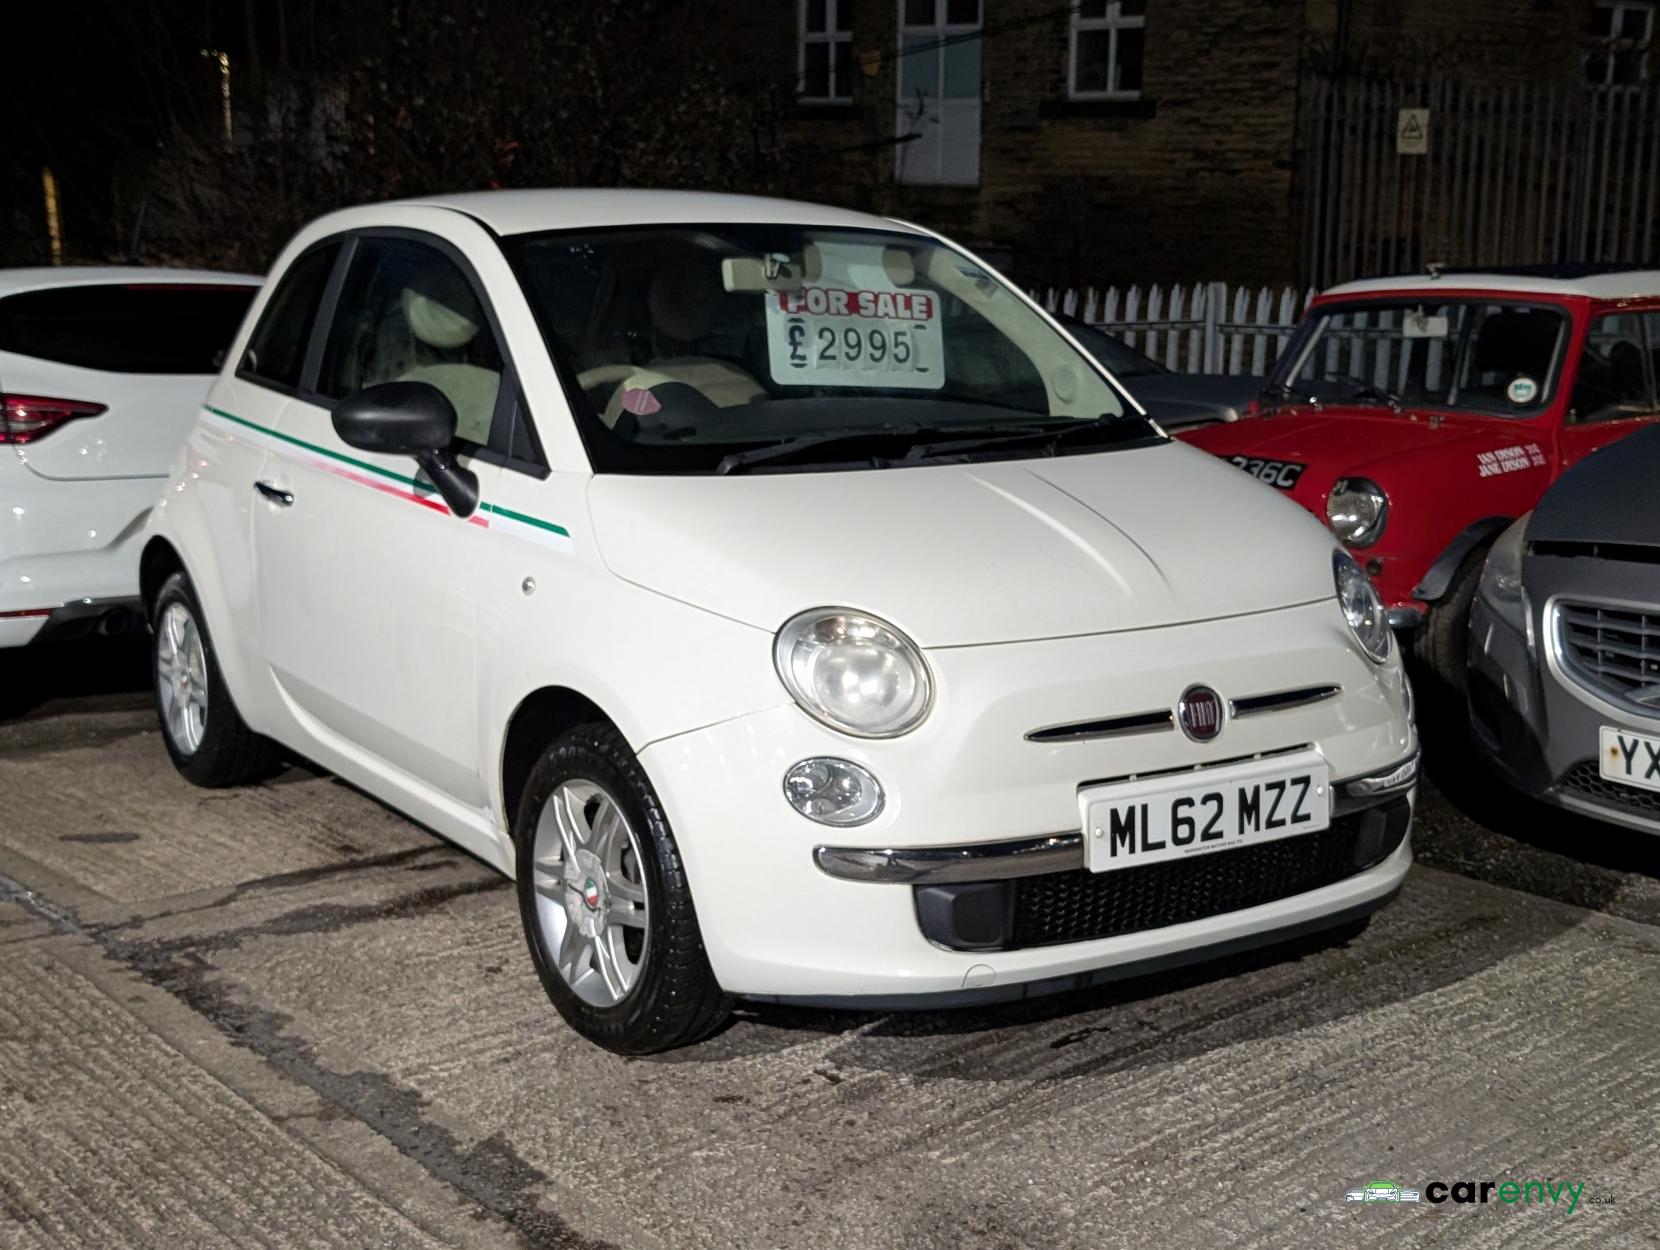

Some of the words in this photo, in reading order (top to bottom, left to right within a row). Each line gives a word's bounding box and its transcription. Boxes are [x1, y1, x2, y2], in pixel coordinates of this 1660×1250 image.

[858, 291, 929, 321] SALE
[1617, 735, 1660, 780] YX
[1110, 792, 1224, 858] ML62
[1238, 775, 1311, 835] MZZ
